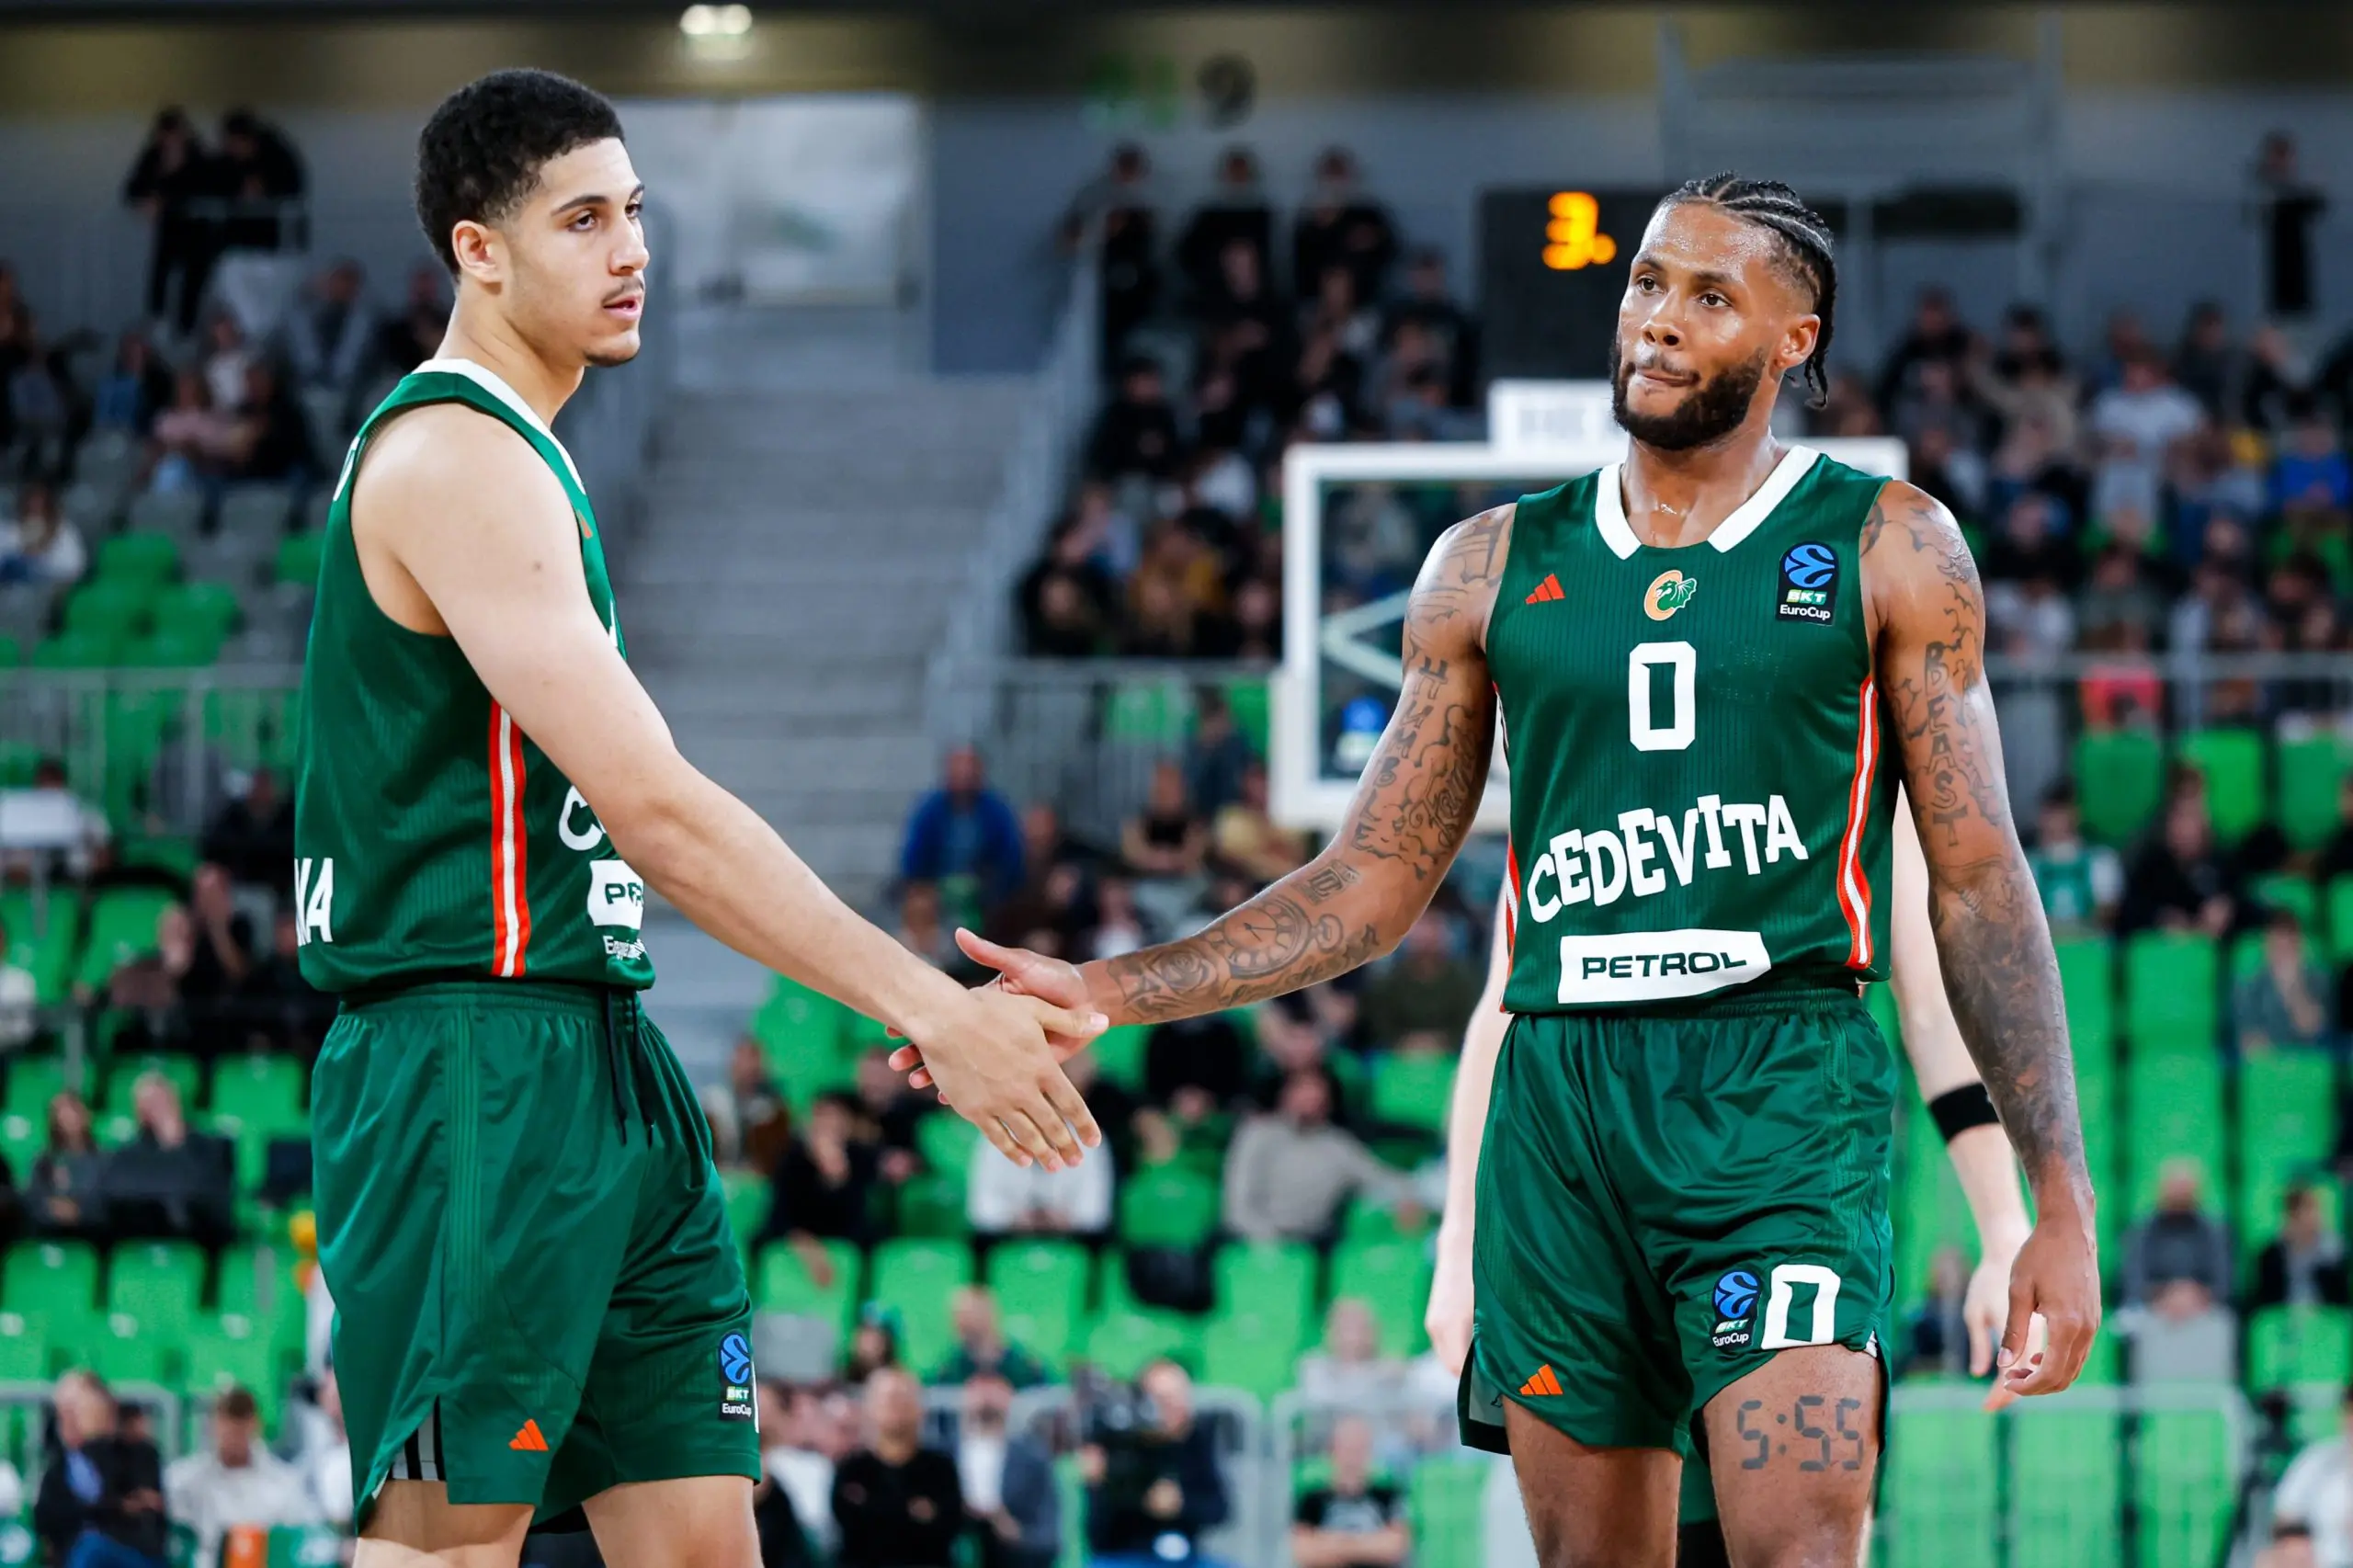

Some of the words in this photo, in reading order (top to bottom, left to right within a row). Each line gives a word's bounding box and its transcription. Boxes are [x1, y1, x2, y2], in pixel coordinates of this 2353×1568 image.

[1779, 604, 1831, 621] EuroCup
[1628, 641, 1697, 752] 0
[1925, 641, 1968, 846] BEAST
[1527, 794, 1809, 923] CEDEVITA
[1582, 951, 1747, 981] PETROL
[1712, 1332, 1749, 1347] EuroCup
[1736, 1394, 1863, 1471] 5:55
